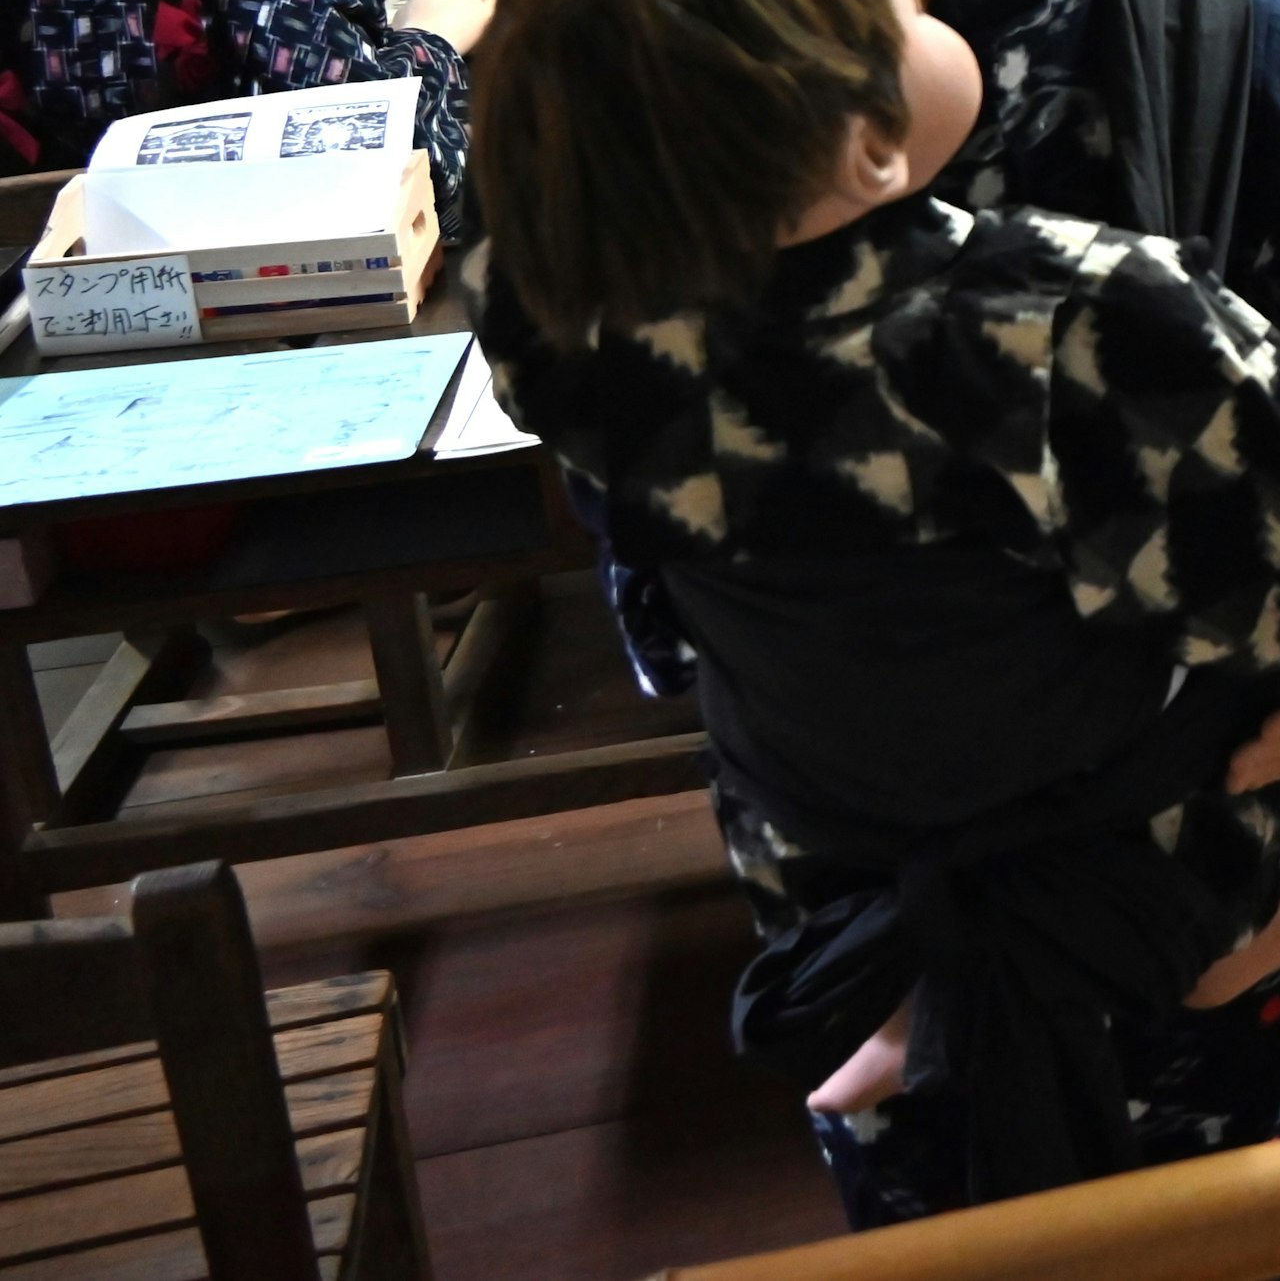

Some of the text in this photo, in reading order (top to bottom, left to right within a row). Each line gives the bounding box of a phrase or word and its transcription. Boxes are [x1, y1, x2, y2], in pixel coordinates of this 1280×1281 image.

[36, 264, 188, 298] スタンプ用紙
